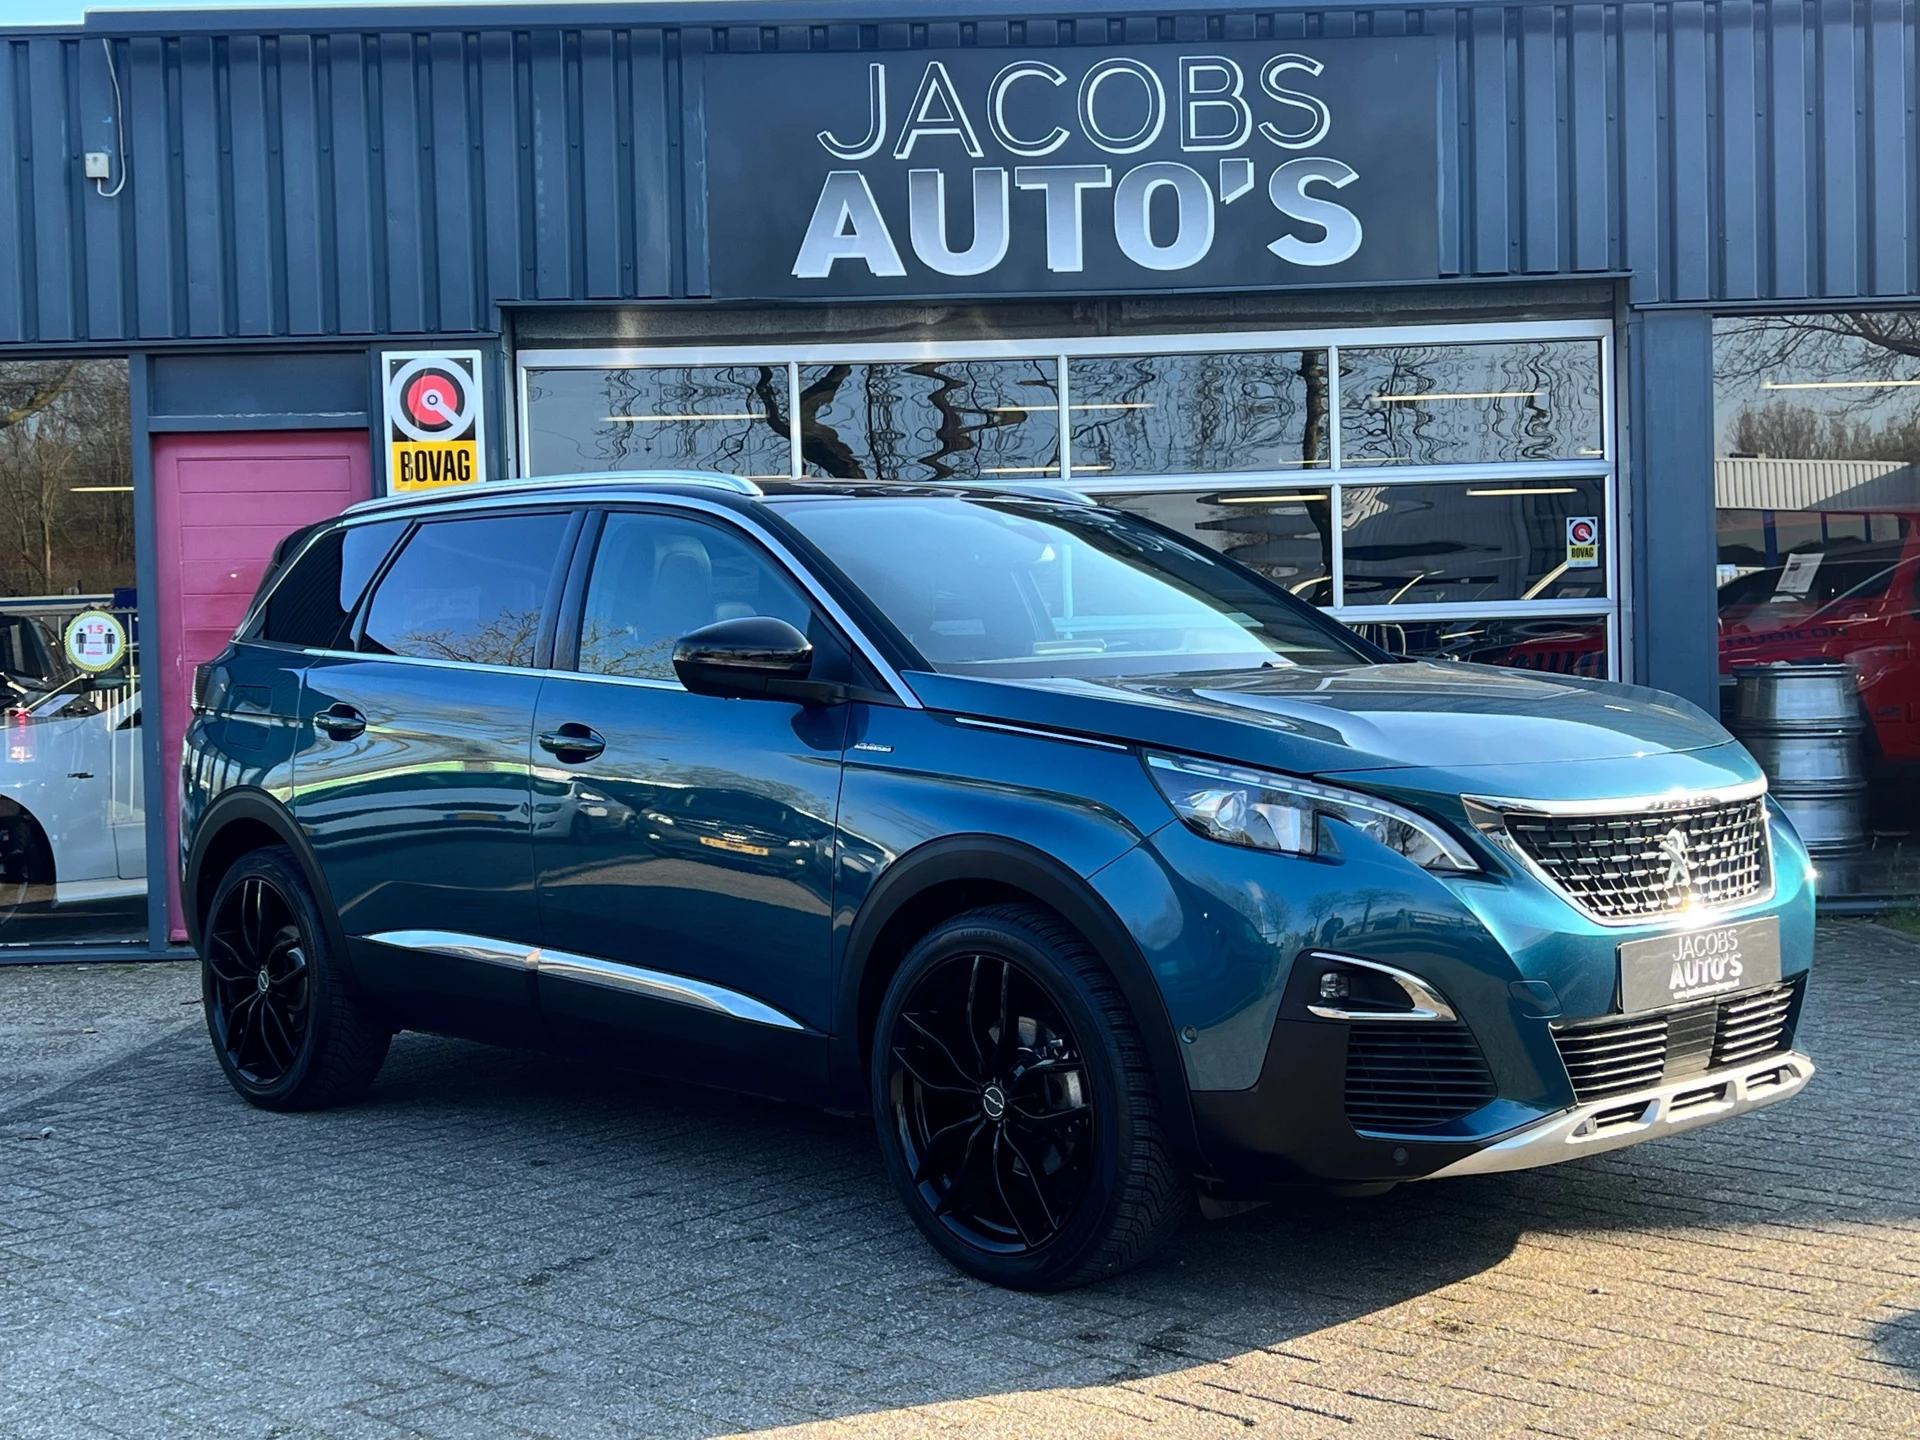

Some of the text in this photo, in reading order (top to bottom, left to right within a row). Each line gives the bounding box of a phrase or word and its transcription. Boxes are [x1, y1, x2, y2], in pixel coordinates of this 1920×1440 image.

[817, 53, 1331, 160] JACOBS
[791, 157, 1363, 277] AUTO'S
[400, 449, 470, 482] BOVAG
[1571, 547, 1594, 558] BOVAG
[87, 624, 104, 634] 1.5
[1726, 627, 1848, 646] RUBICON
[1672, 929, 1738, 961] JACOBS
[1669, 952, 1743, 989] AUTO'S
